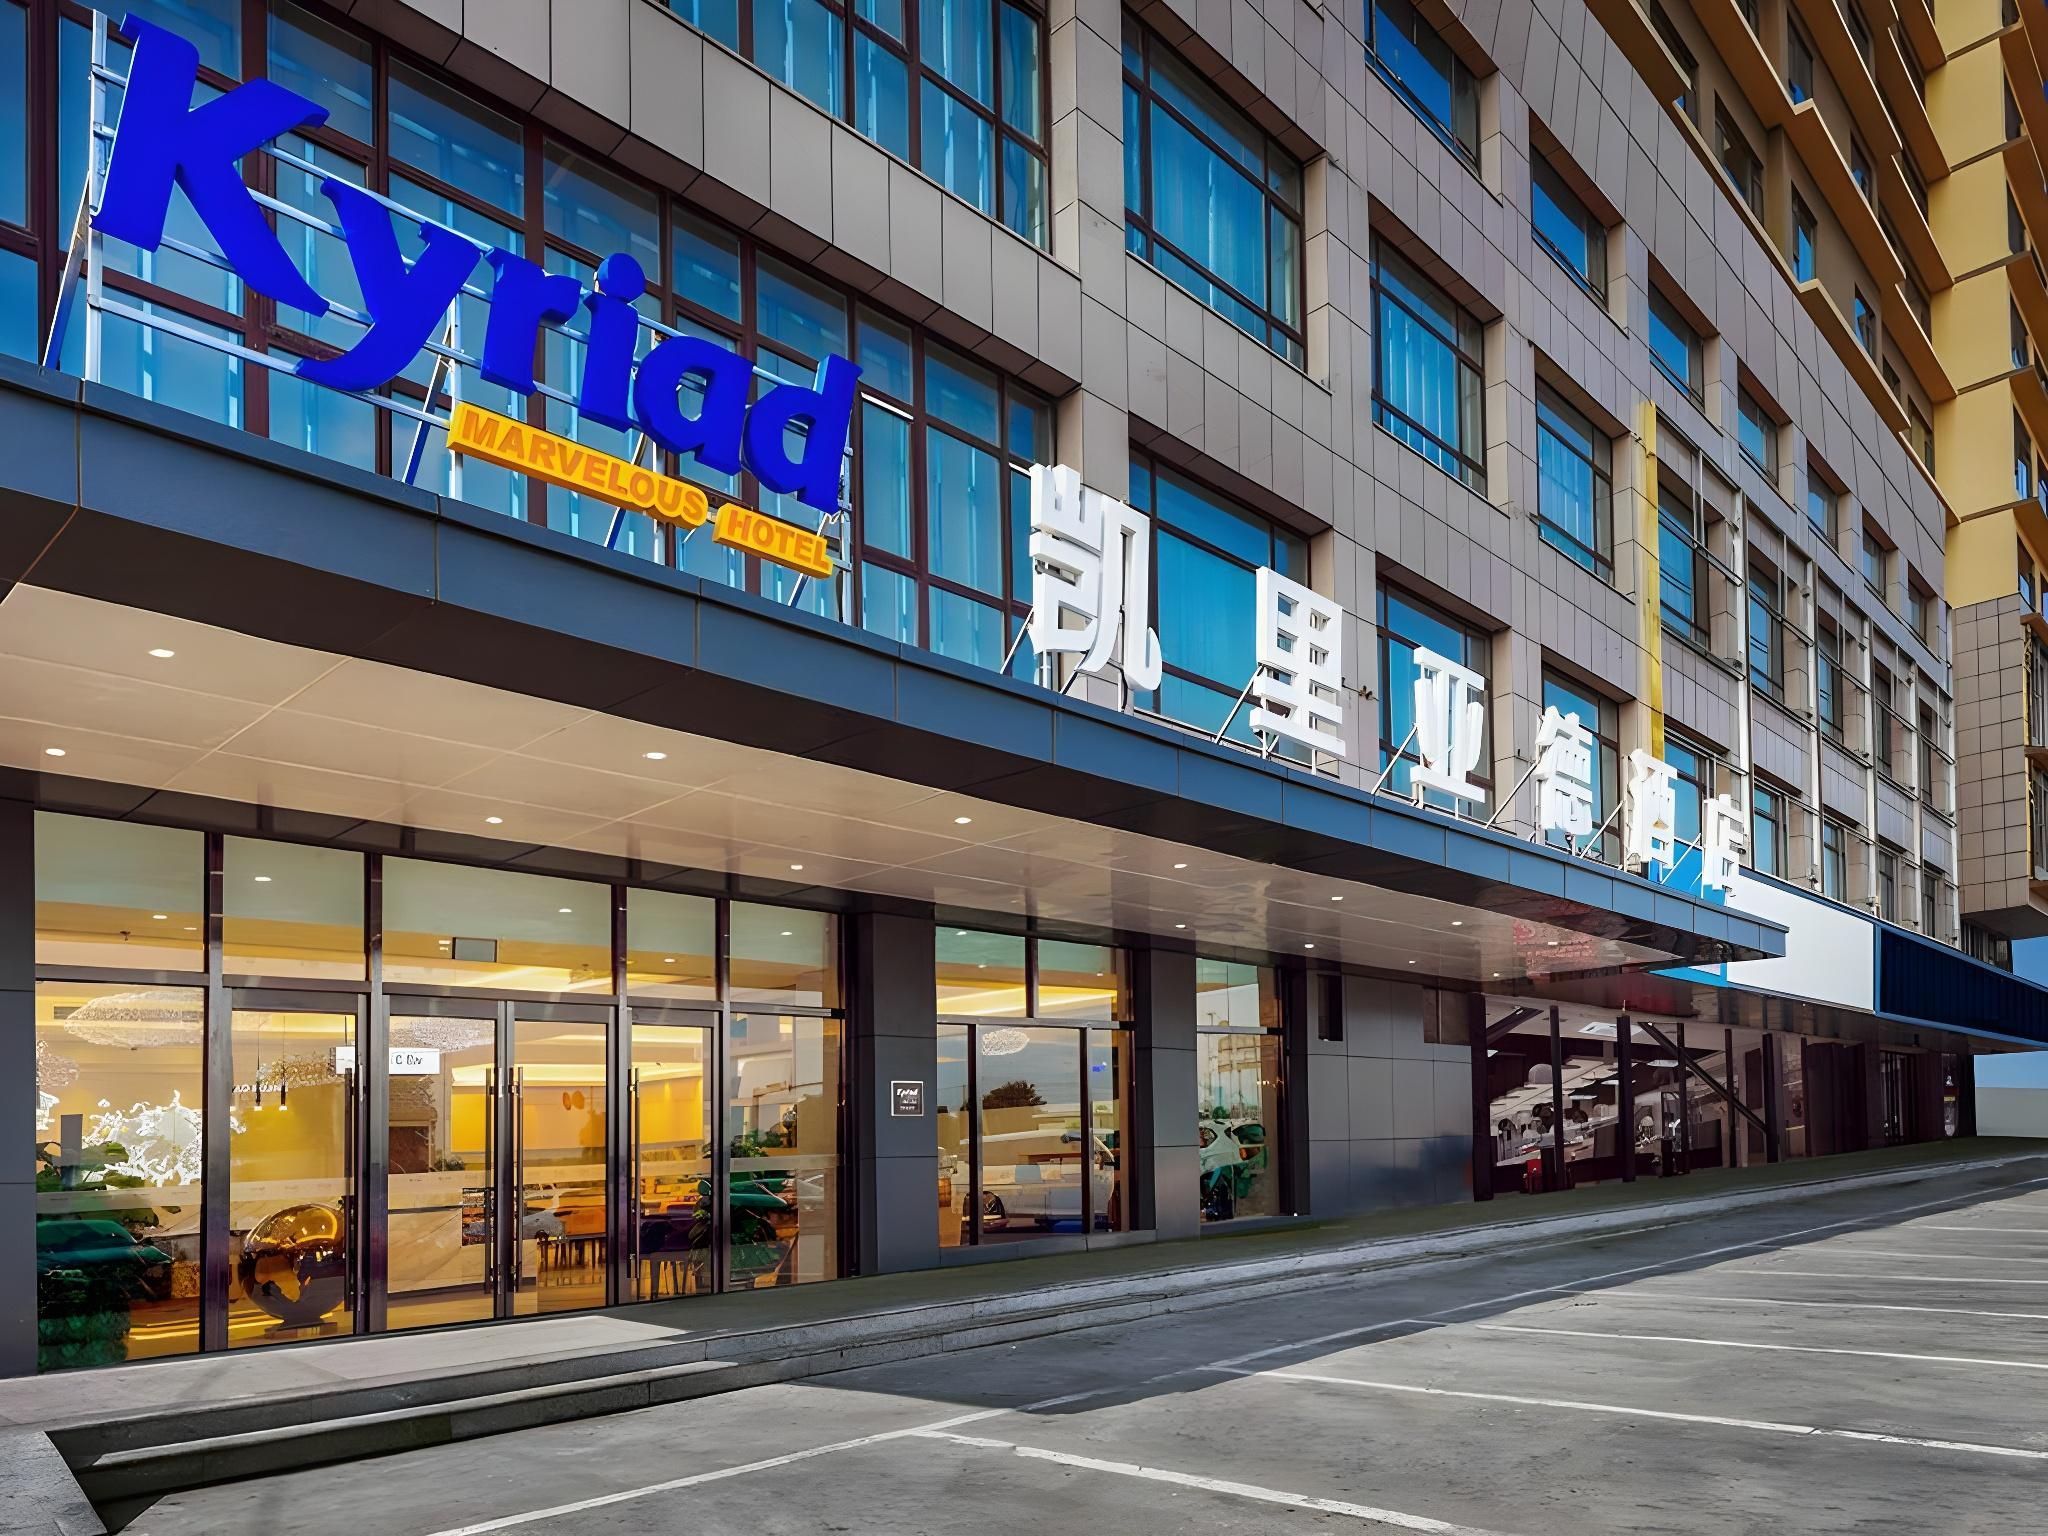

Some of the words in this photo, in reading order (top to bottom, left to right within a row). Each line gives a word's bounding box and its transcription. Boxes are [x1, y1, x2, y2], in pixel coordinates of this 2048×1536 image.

[91, 13, 863, 515] Kyriad
[461, 409, 704, 521] MARVELOUS
[726, 508, 831, 569] HOTEL
[1029, 462, 1745, 894] 凯里亚德酒店
